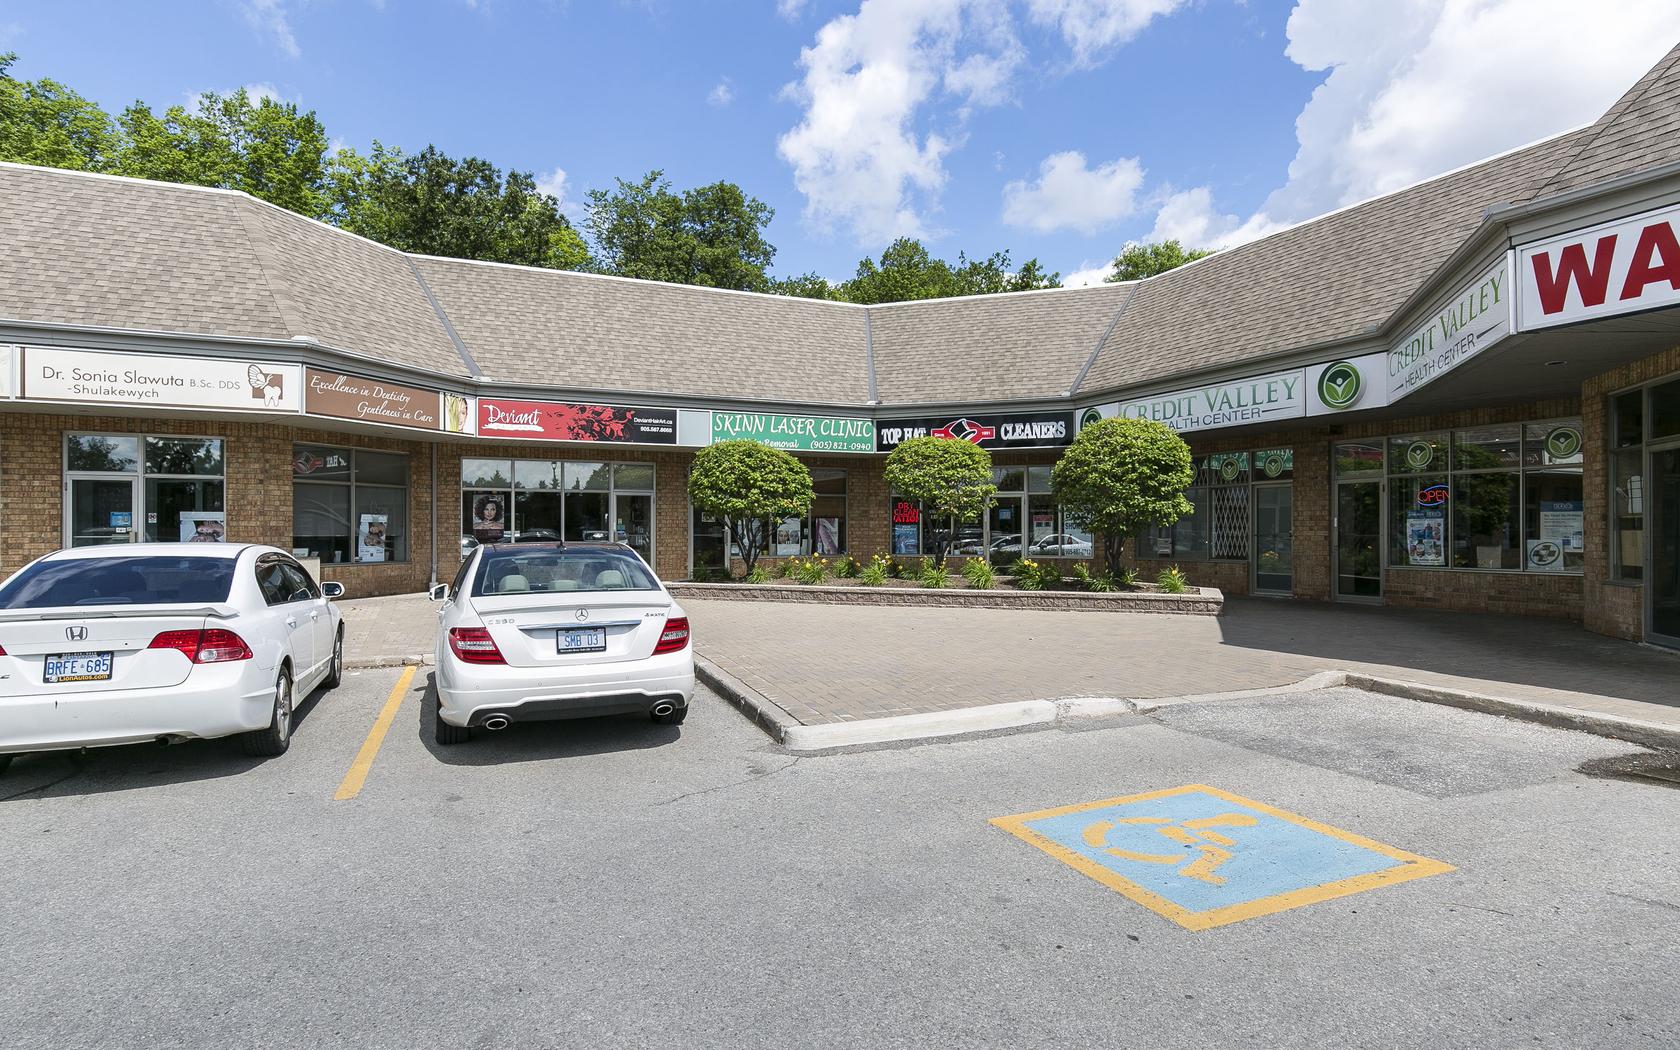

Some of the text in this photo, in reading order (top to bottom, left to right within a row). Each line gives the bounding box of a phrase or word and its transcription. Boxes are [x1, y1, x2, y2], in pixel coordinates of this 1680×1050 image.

[1531, 221, 1680, 316] WA
[1389, 269, 1504, 377] CREDIT VALLEY
[1405, 332, 1476, 389] HEALTH CENTER
[42, 366, 241, 390] Dr. Sonia Slawuta B.Sc. DDS
[310, 375, 411, 410] Excellence in Dentistry
[1202, 378, 1298, 413] VALLEY
[357, 399, 433, 423] Gentleness in Care
[481, 404, 543, 425] Deviant
[1165, 408, 1261, 429] ALTH CENTER
[714, 413, 872, 439] SKINN LASER CLINIC
[881, 427, 927, 444] TOP HAT
[1001, 421, 1066, 440] CLEANERS
[1417, 490, 1449, 502] OPEN
[565, 634, 582, 647] SMB
[47, 658, 109, 676] BRFE 685
[59, 673, 108, 682] LionAutos.com
